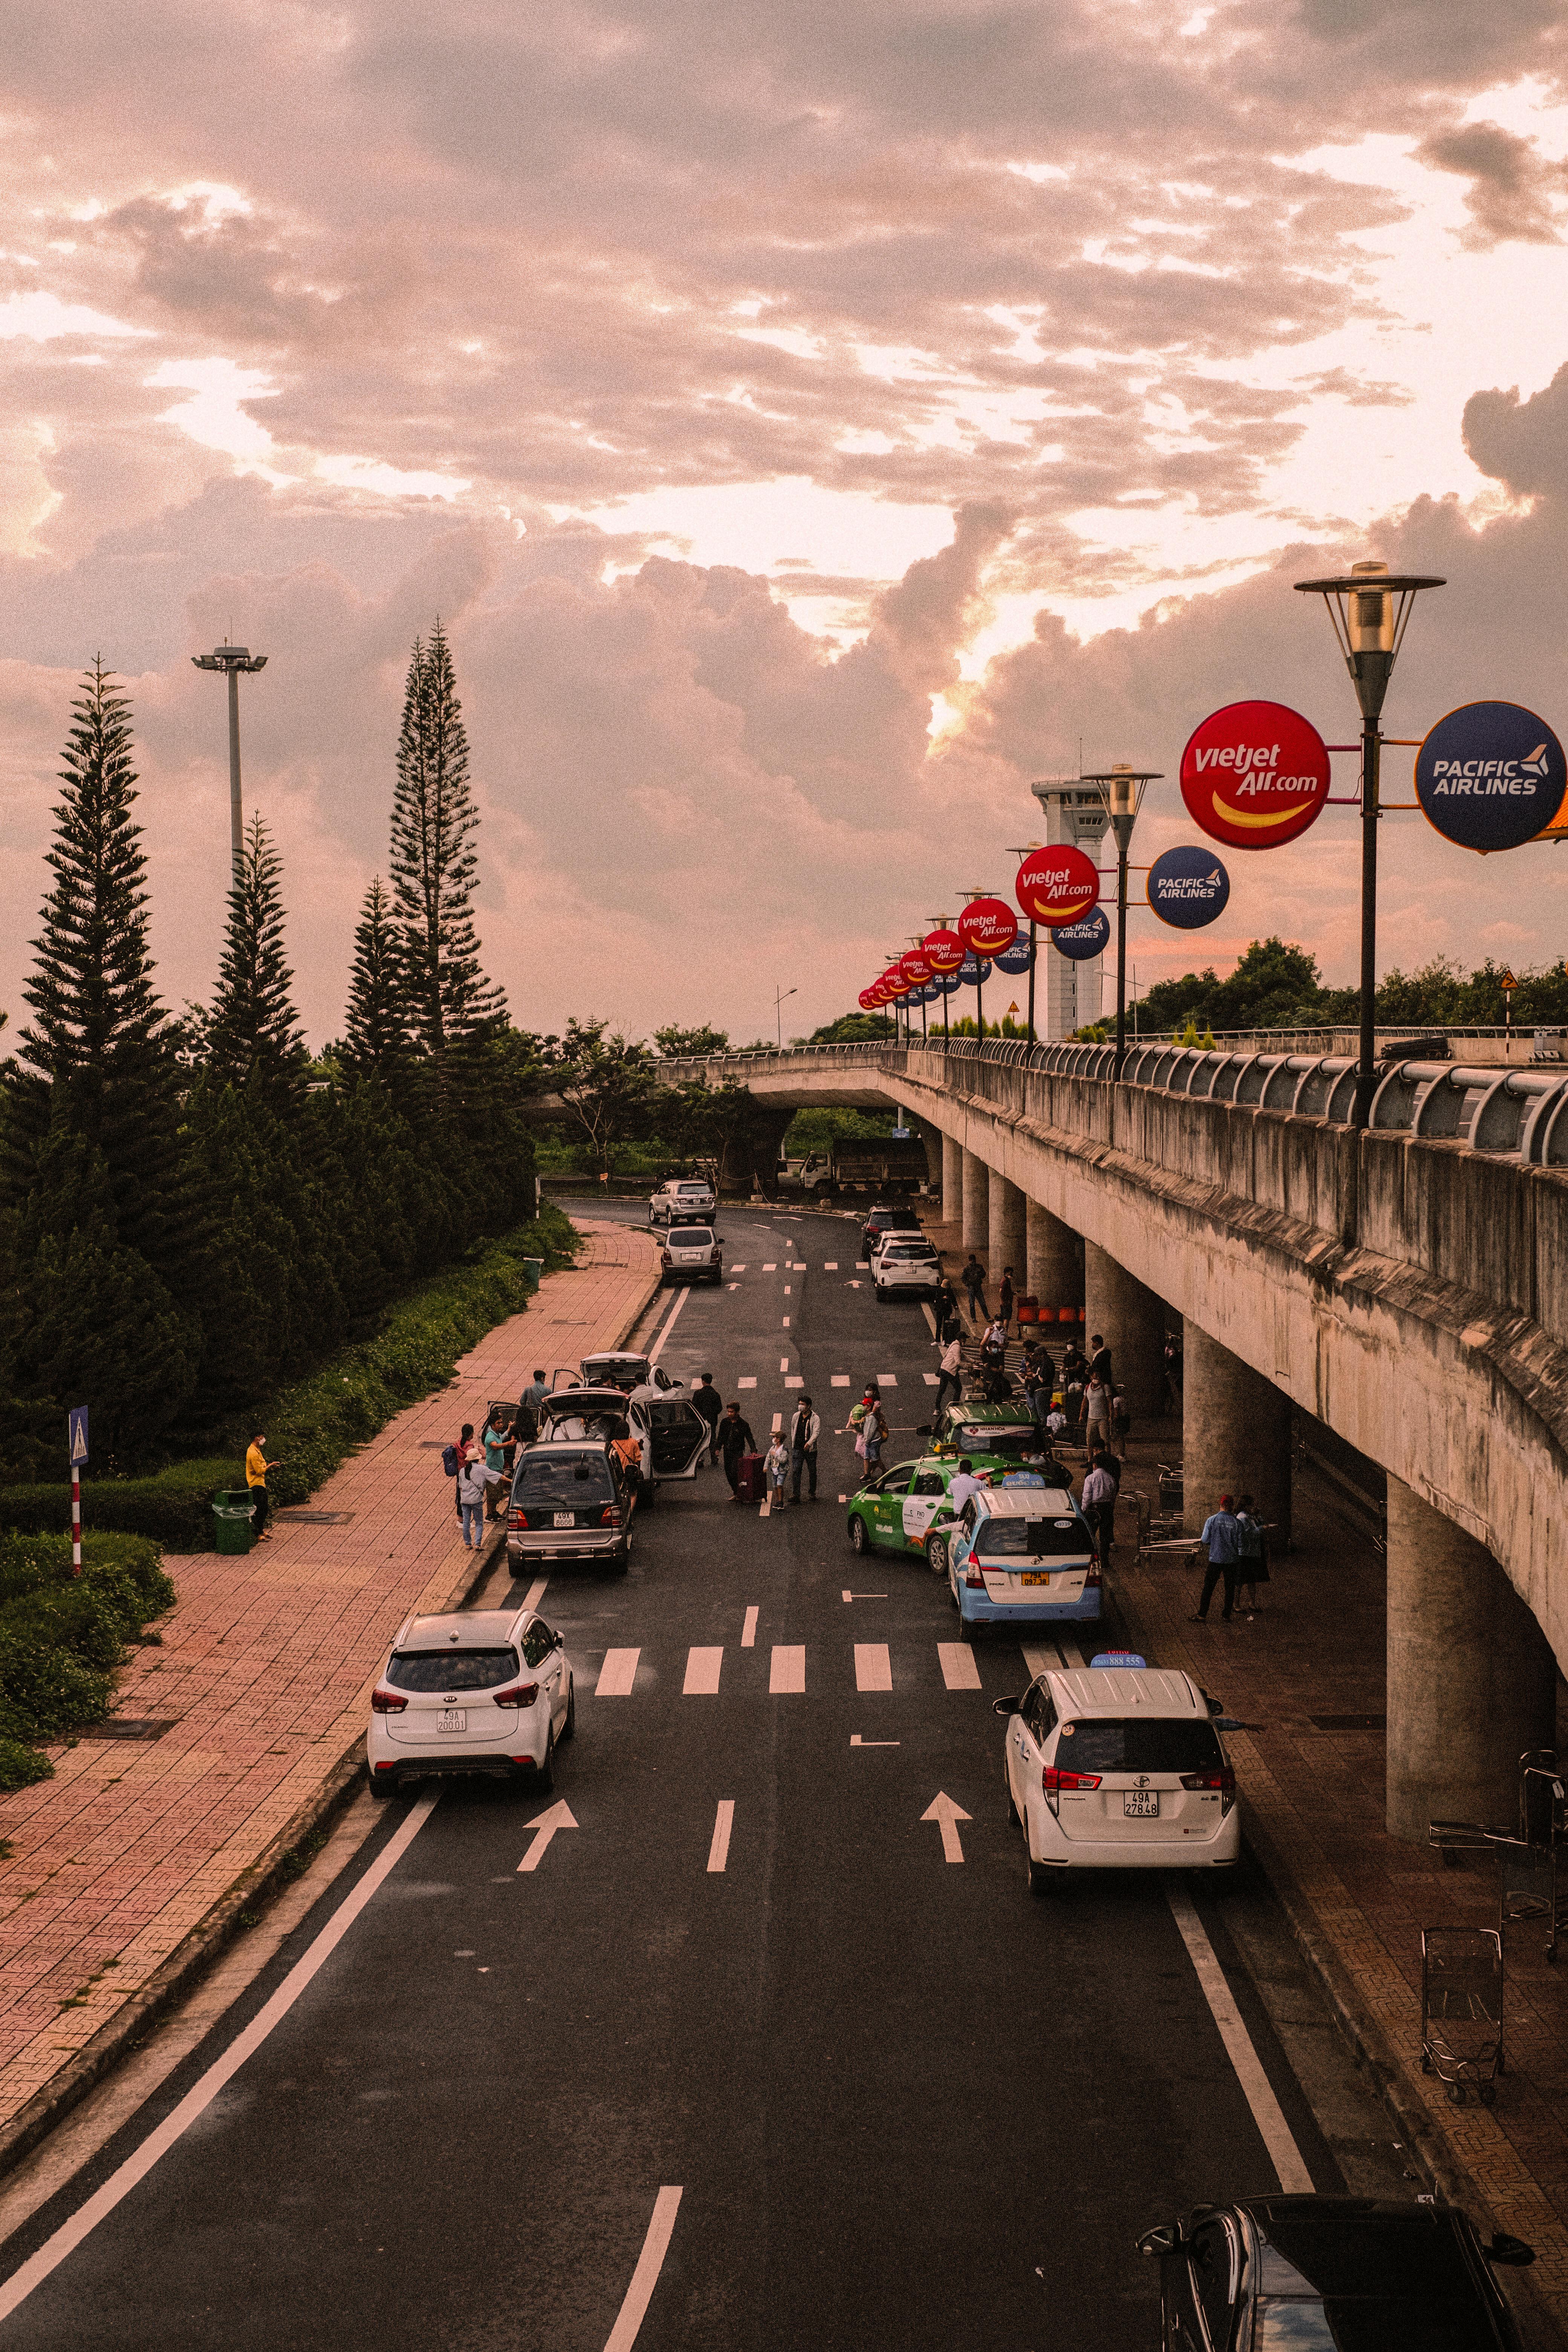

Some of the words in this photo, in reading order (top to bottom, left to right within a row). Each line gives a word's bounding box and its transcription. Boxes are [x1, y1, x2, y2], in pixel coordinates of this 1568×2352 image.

[1433, 760, 1518, 777] PACIFIC
[1433, 778, 1537, 795] AIRLINES
[1158, 878, 1205, 888] PACIFIC
[1158, 888, 1215, 898] AIRLINES
[1110, 1657, 1123, 1665] 888
[1126, 1657, 1140, 1665] 555
[444, 1711, 459, 1720] 49A
[438, 1720, 464, 1730] 200.01
[1132, 1792, 1150, 1803] 49A
[1125, 1804, 1157, 1814] 278.48
